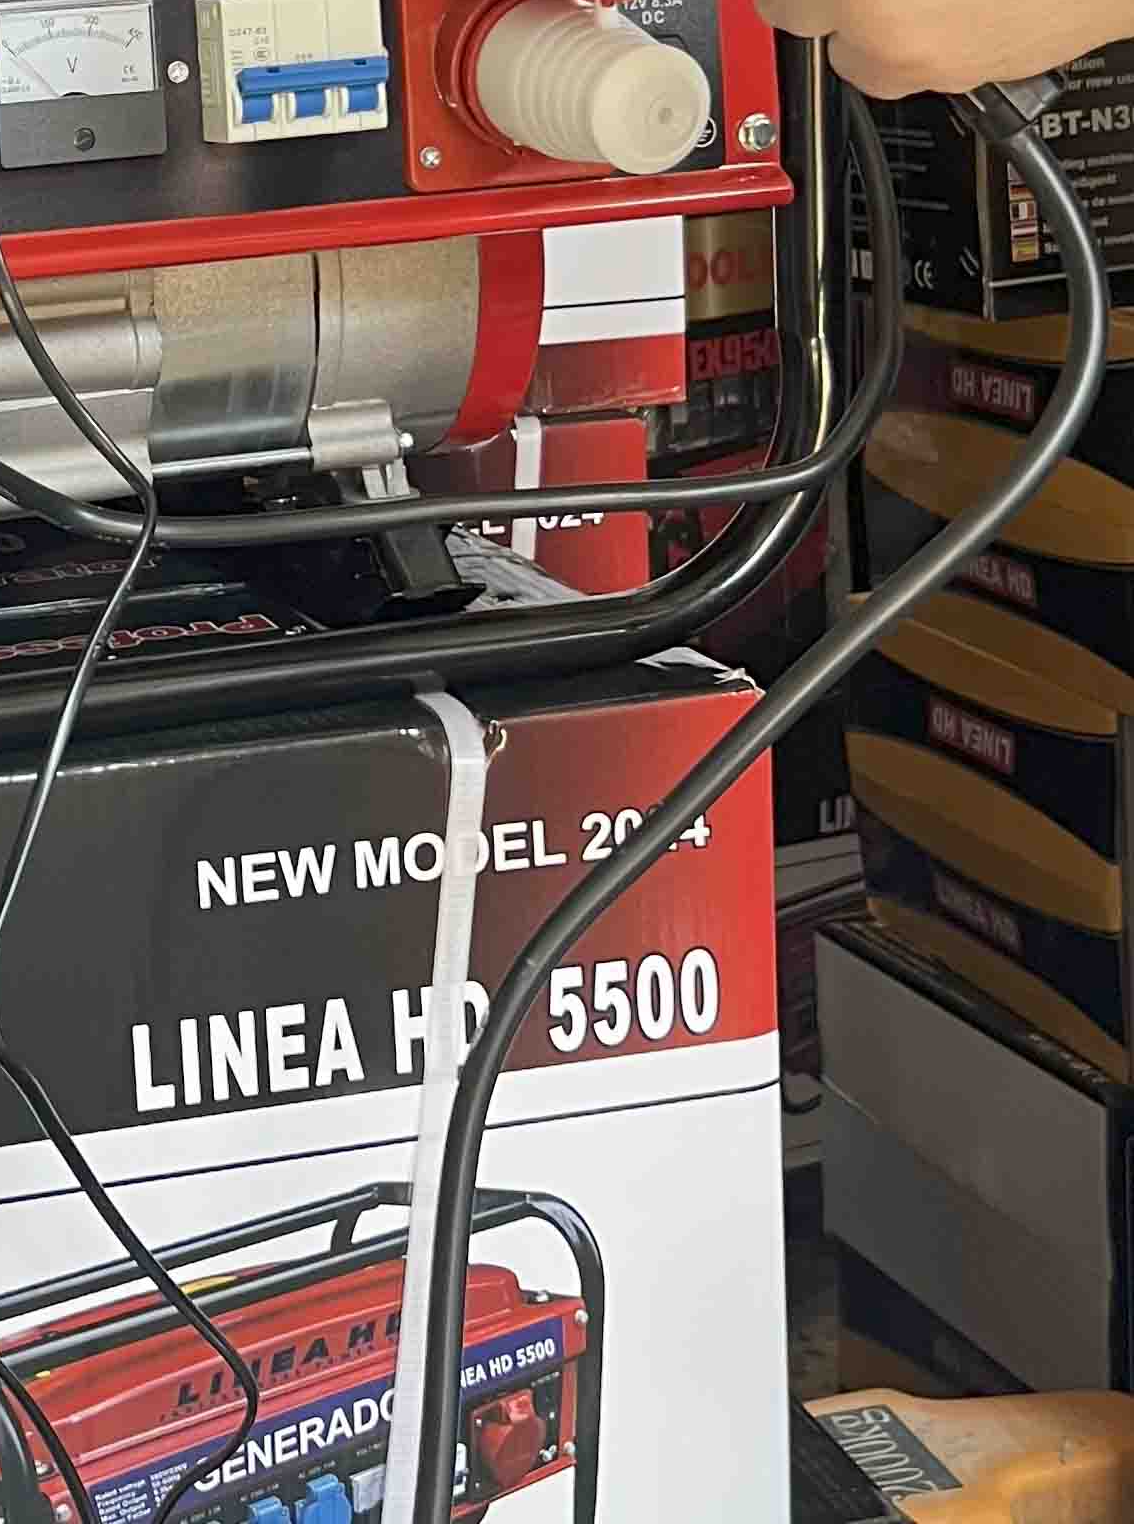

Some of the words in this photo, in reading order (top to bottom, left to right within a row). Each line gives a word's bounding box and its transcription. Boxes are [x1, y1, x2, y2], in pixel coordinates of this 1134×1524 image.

[641, 10, 665, 26] DC
[66, 53, 78, 74] V
[197, 844, 337, 909] NEW
[581, 808, 711, 863] 204
[132, 997, 365, 1113] LINEA
[548, 947, 720, 1053] 5500
[488, 1354, 514, 1377] HD
[515, 1337, 556, 1369] 5500
